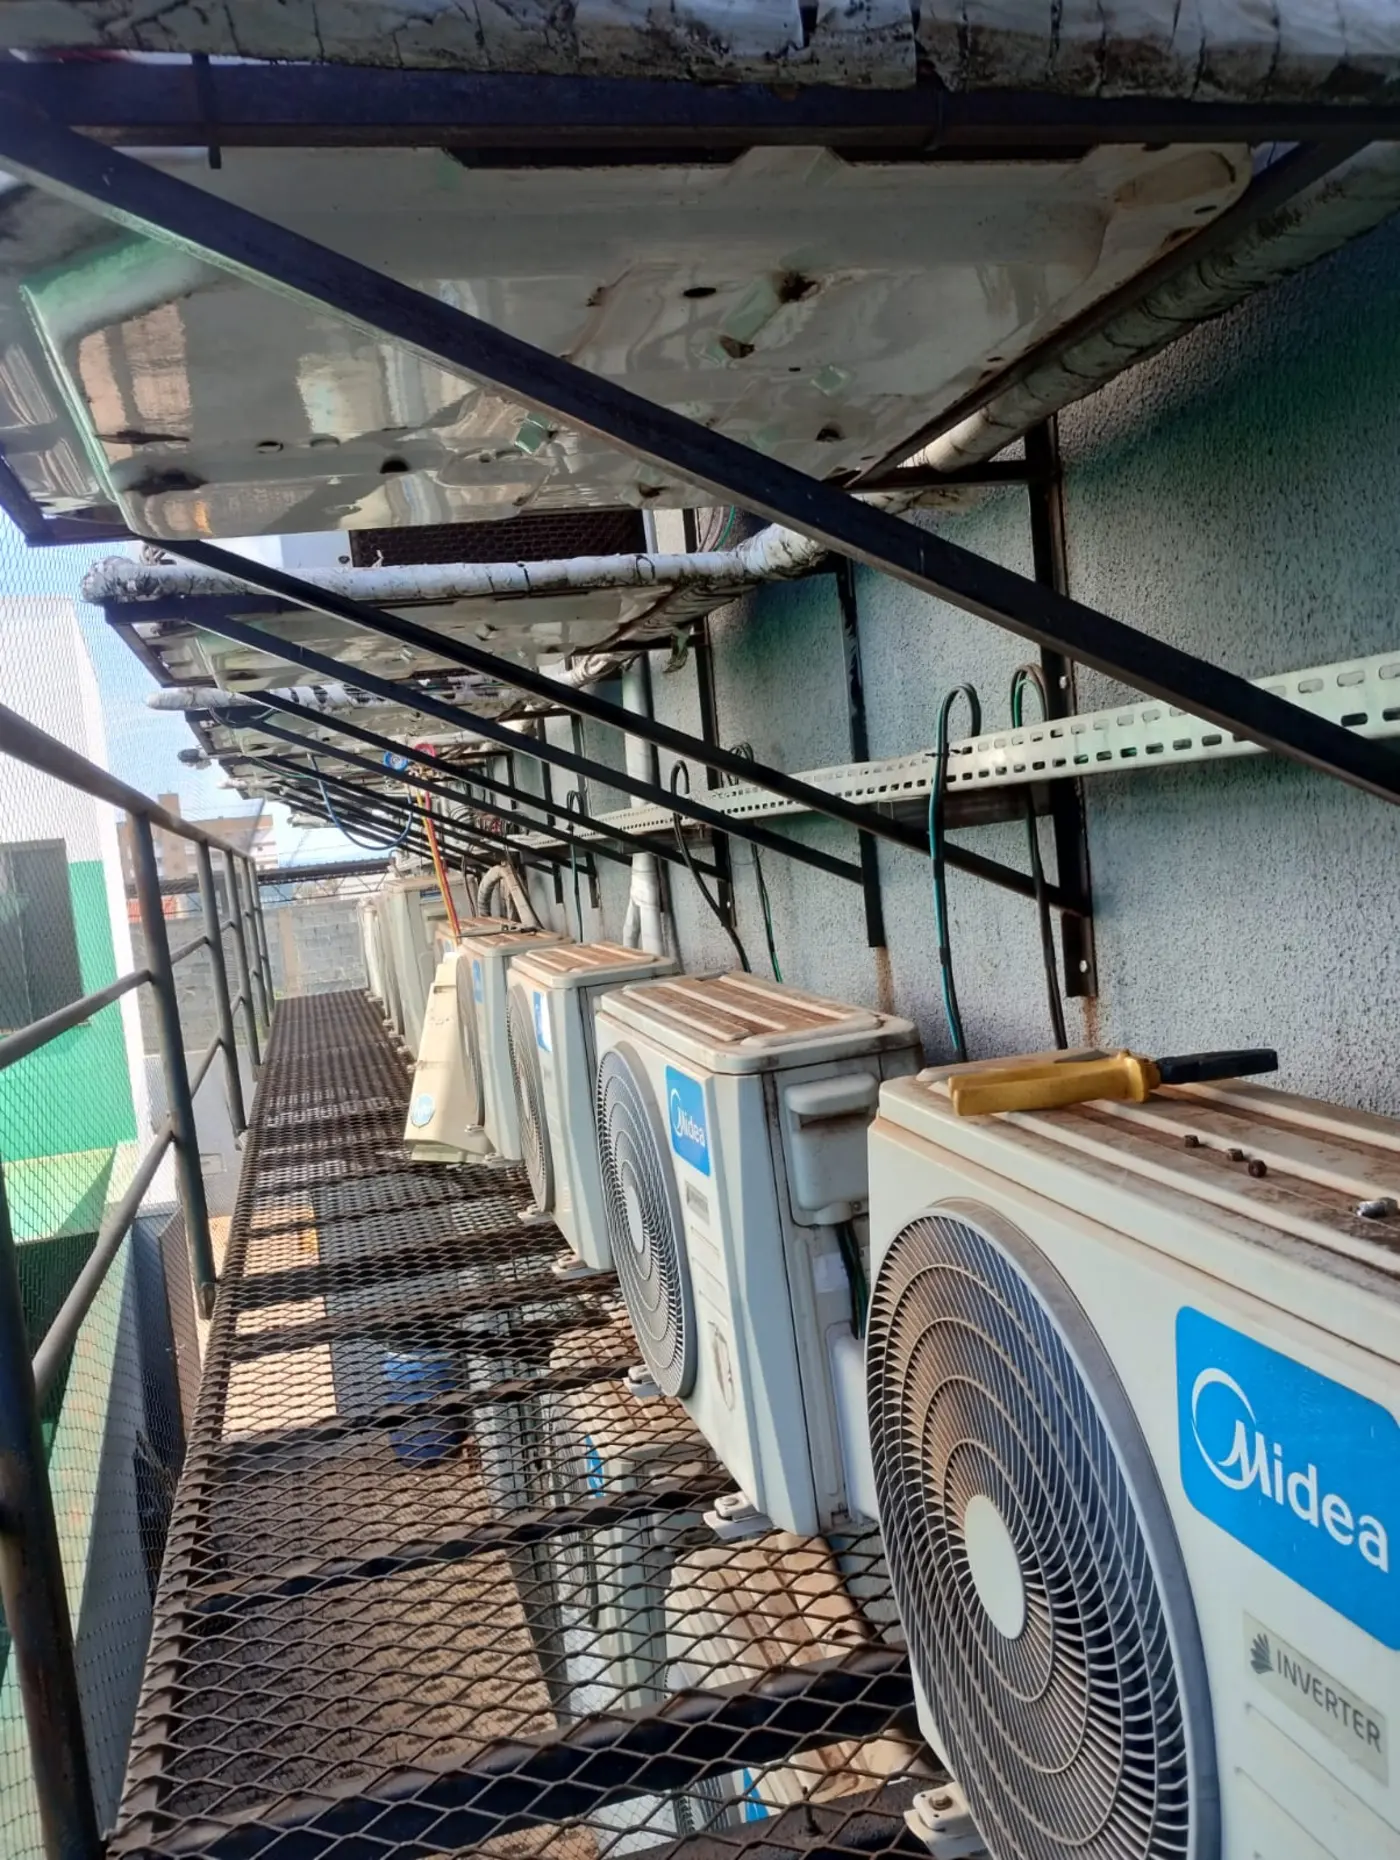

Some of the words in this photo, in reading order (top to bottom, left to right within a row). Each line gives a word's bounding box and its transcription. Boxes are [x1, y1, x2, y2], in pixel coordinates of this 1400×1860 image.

[671, 1089, 705, 1147] Midea
[1192, 1367, 1389, 1573] Midea
[1277, 1649, 1382, 1754] INVERTER
